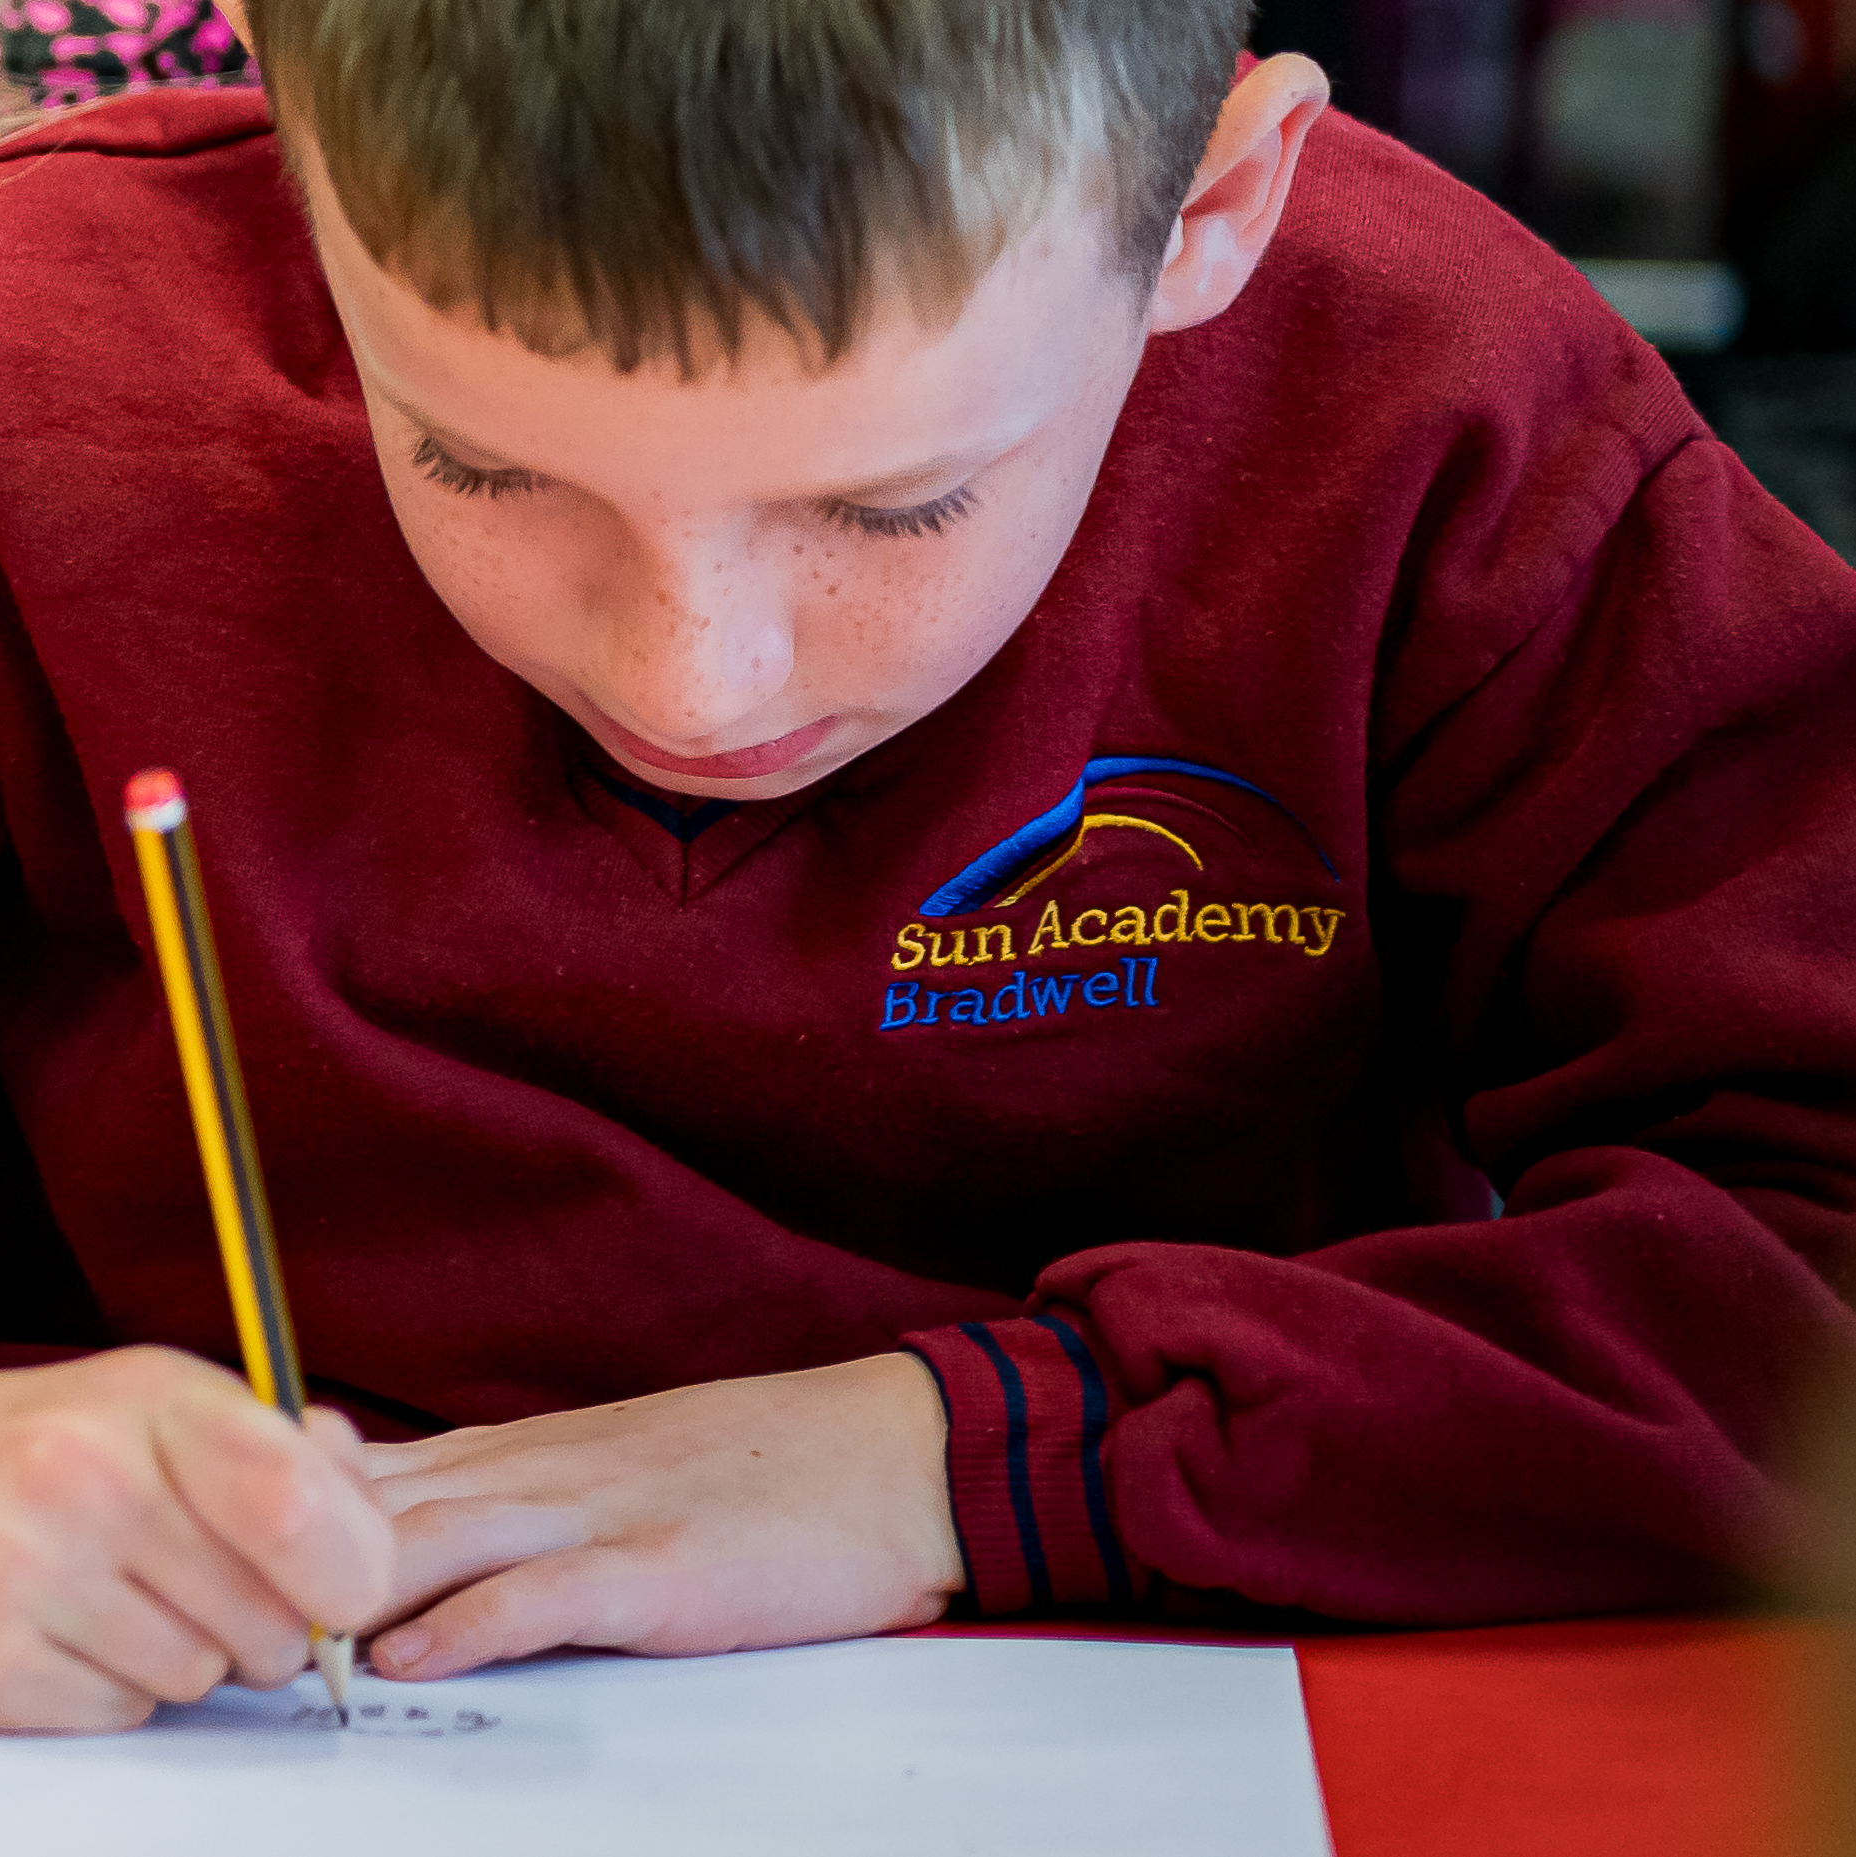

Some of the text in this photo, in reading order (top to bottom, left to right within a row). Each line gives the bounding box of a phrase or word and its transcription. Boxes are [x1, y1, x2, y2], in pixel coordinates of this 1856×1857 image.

[892, 890, 1347, 971] Sun Academy
[880, 957, 1159, 1031] Bradwell
